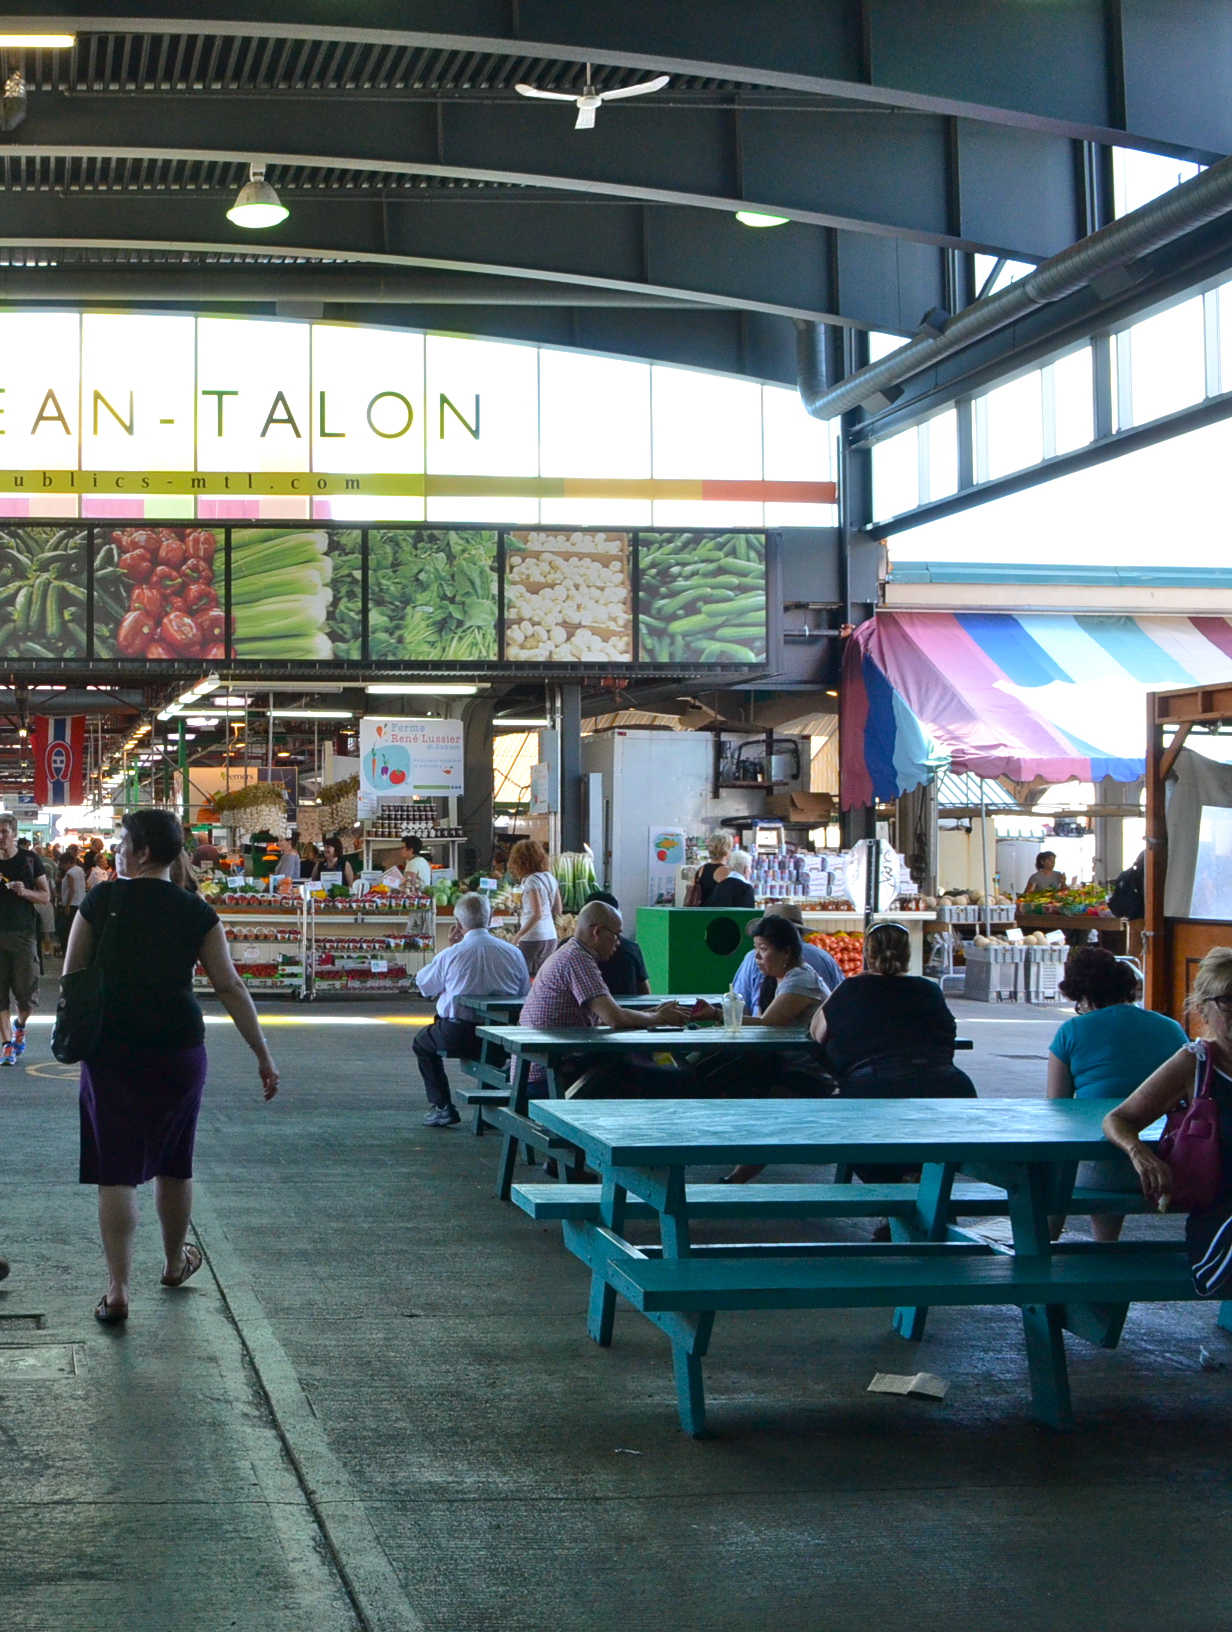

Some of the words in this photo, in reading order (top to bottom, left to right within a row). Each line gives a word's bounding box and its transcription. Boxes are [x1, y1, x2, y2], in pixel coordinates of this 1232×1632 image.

[391, 723, 426, 733] Ferme
[391, 733, 418, 743] René
[421, 735, 461, 743] Lussier
